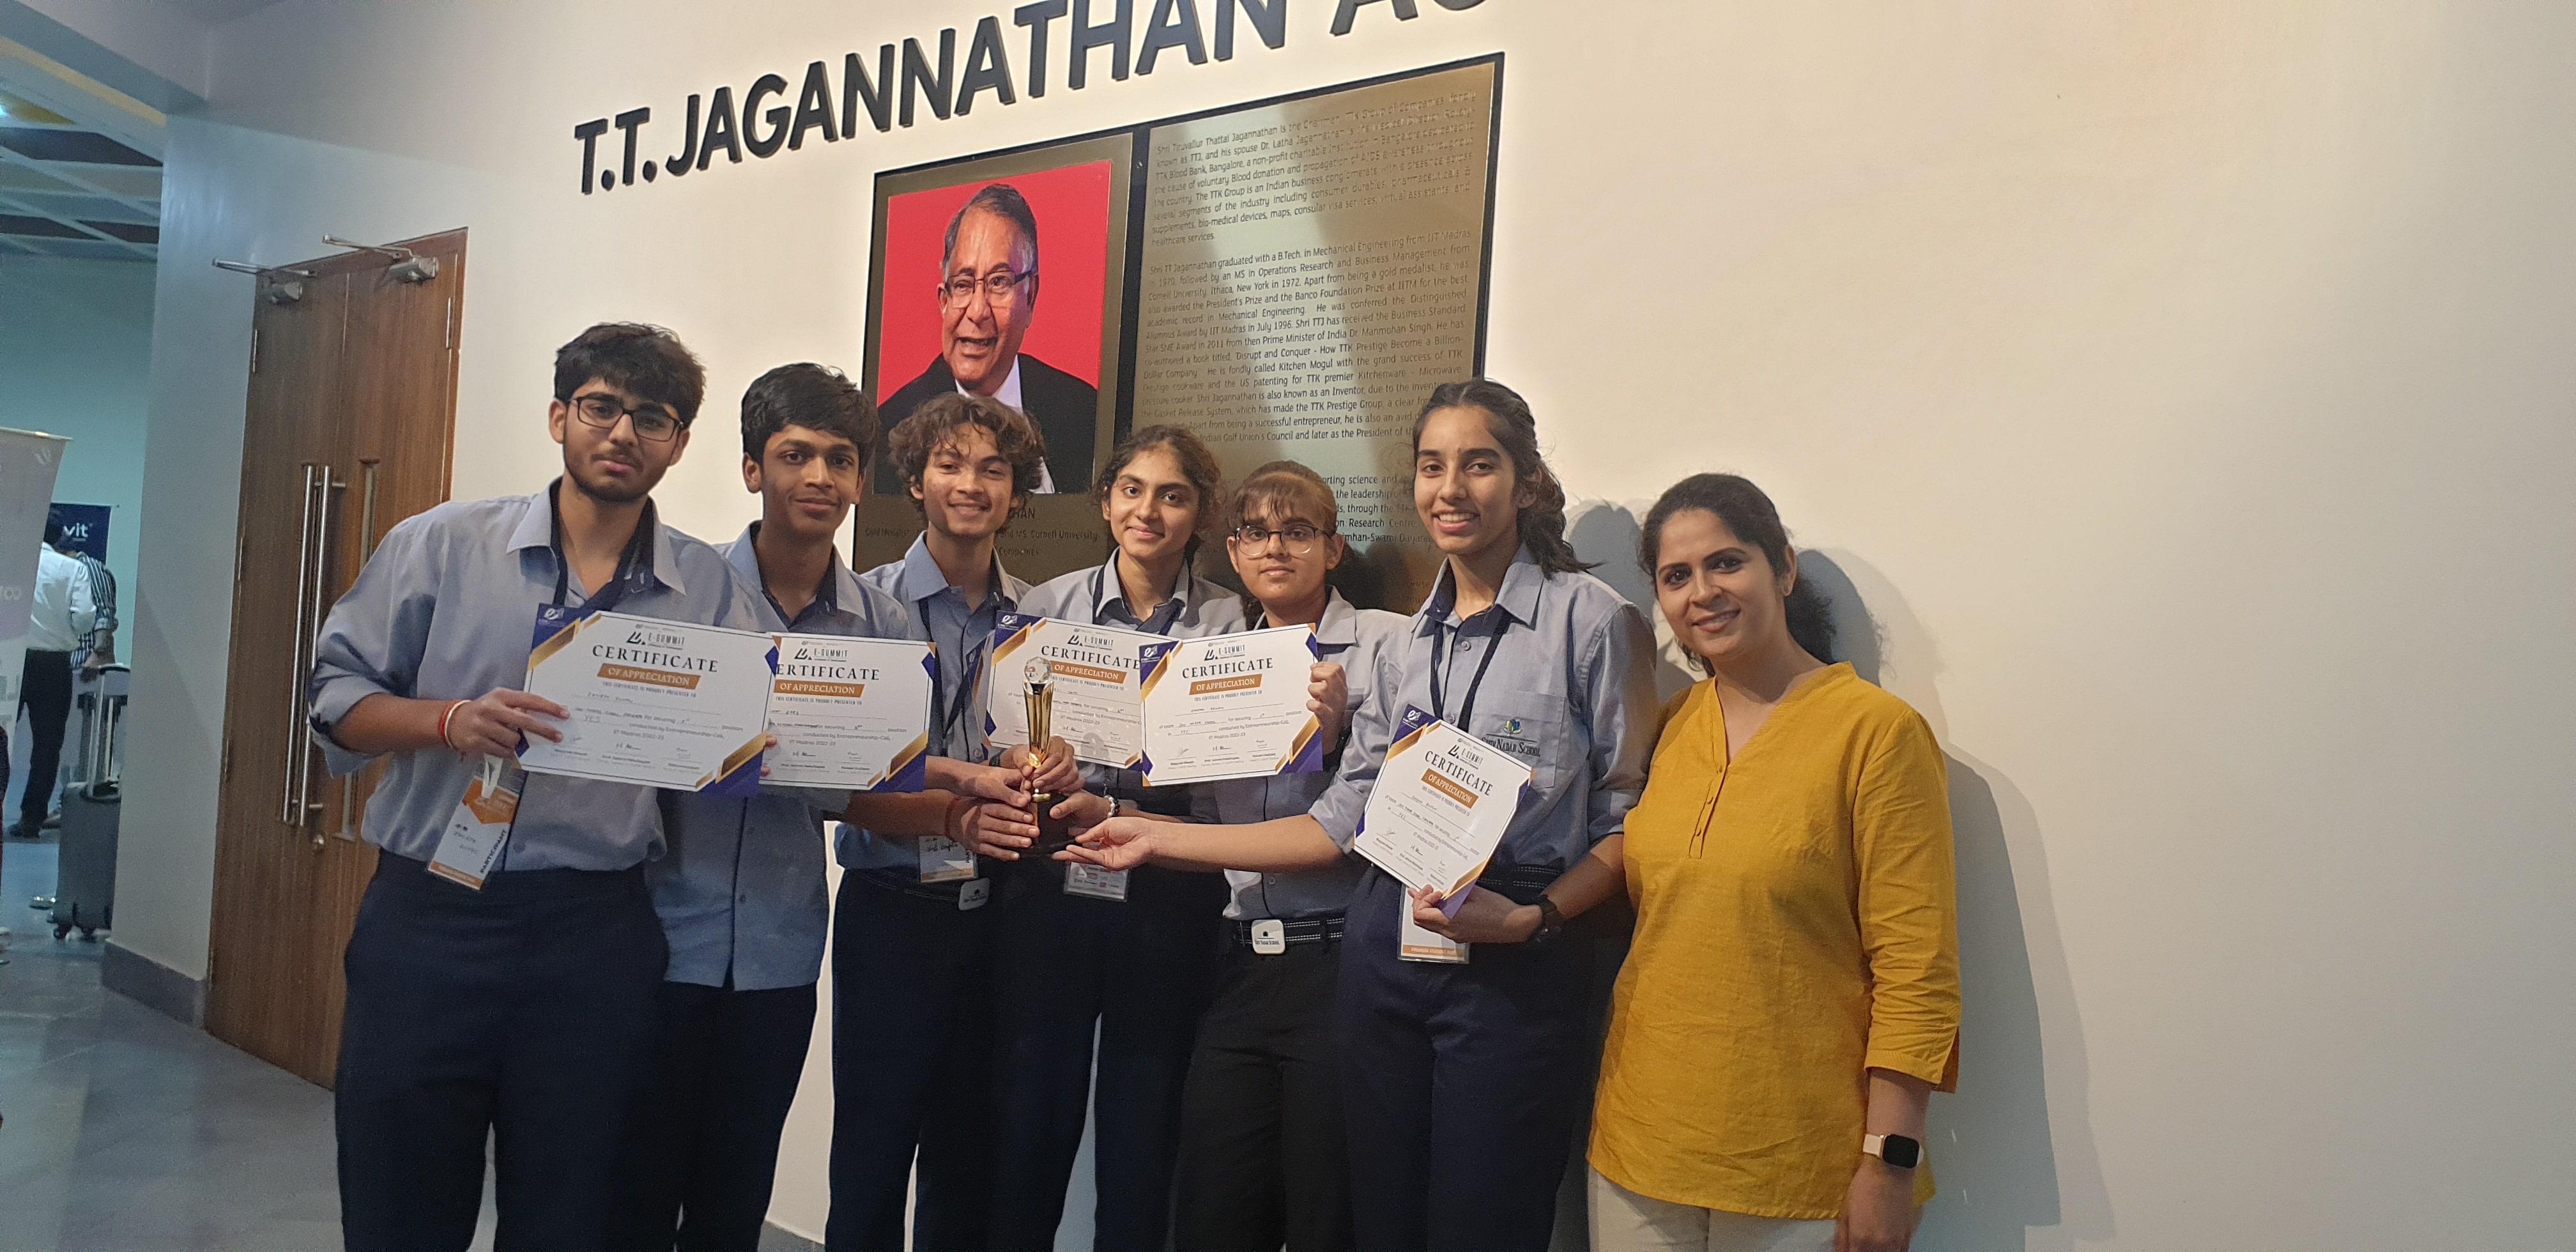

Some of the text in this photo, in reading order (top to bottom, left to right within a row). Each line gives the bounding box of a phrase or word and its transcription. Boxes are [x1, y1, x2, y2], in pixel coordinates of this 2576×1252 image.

[574, 0, 1287, 195] T.T. JAGANNATHAN
[1231, 126, 1280, 142] Jagannathan
[1280, 123, 1288, 134] is
[1205, 148, 1220, 160] and
[1219, 147, 1231, 157] his
[1233, 144, 1257, 156] spouse
[1271, 136, 1293, 148] Latha
[1250, 151, 1288, 166] non-profit
[1197, 162, 1301, 188] voluntary Blood donation and
[1196, 176, 1323, 202] The TTK Group is an Indian business
[1225, 201, 1236, 211] the
[1239, 196, 1270, 209] industry
[1273, 191, 1307, 204] including
[1269, 208, 1291, 218] maps,
[1217, 254, 1255, 270] graduated
[1255, 252, 1270, 263] with
[1303, 248, 1311, 257] in
[1311, 241, 1356, 257] Mechanical
[1234, 254, 1389, 279] MS Operations Research and Business
[1235, 270, 1369, 293] New York 1972. Apart from being
[1245, 295, 1262, 305] Prize
[1293, 291, 1318, 300] Banco
[1319, 285, 1364, 298] Foundation
[1218, 309, 1258, 321] Mechanical
[1315, 302, 1326, 312] He
[1331, 302, 1346, 311] was
[1256, 321, 1272, 332] July
[1274, 319, 1292, 330] 1996.
[1295, 317, 1310, 328] Shri
[1326, 316, 1340, 325] has
[1225, 338, 1243, 347] from
[1244, 336, 1261, 346] then
[1262, 334, 1284, 344] Prime
[1284, 332, 1315, 342] Minister
[1317, 330, 1324, 340] of
[1326, 328, 1347, 339] India
[1279, 347, 1310, 358] Conquer
[1319, 344, 1336, 354] How
[1339, 342, 1353, 353] TTK
[1254, 353, 1397, 372] called Kitchen Mogul with the grand
[1252, 371, 1354, 388] patenting for TTK premier
[1265, 385, 1365, 399] also known Inventor,
[1271, 399, 1384, 413] made TTK Prestige Group,
[1255, 413, 1383, 427] successful entrepreneur, also
[1265, 430, 1296, 441] Council
[1295, 429, 1310, 439] and
[1310, 429, 1329, 439] later
[1354, 427, 1392, 438] President
[1393, 426, 1402, 436] of
[1322, 475, 1396, 487] orting science and
[1337, 489, 1392, 500] the leadership
[1347, 504, 1378, 514] through
[1349, 519, 1384, 528] Research
[1084, 635, 1114, 646] E-SUMMIT
[1218, 644, 1245, 655] E-SUMMIT
[590, 643, 719, 673] CERTIFICATE
[813, 647, 848, 657] E-SUMMIT
[1040, 644, 1141, 670] CERTIFICATE
[607, 666, 690, 685] OF APPRECIATION
[776, 662, 880, 681] ERTIFICATE
[1054, 663, 1119, 680] OF APPRECIATION
[1181, 657, 1273, 679] CERTIFICATE
[778, 682, 855, 694] OF APPRECIATION
[1195, 677, 1255, 691] OF APPRECIATION
[1423, 749, 1494, 796] CERTIFICATE
[1427, 772, 1437, 783] OF
[1434, 777, 1472, 804] APPRECIATION
[480, 829, 507, 874] PARTICIPANT
